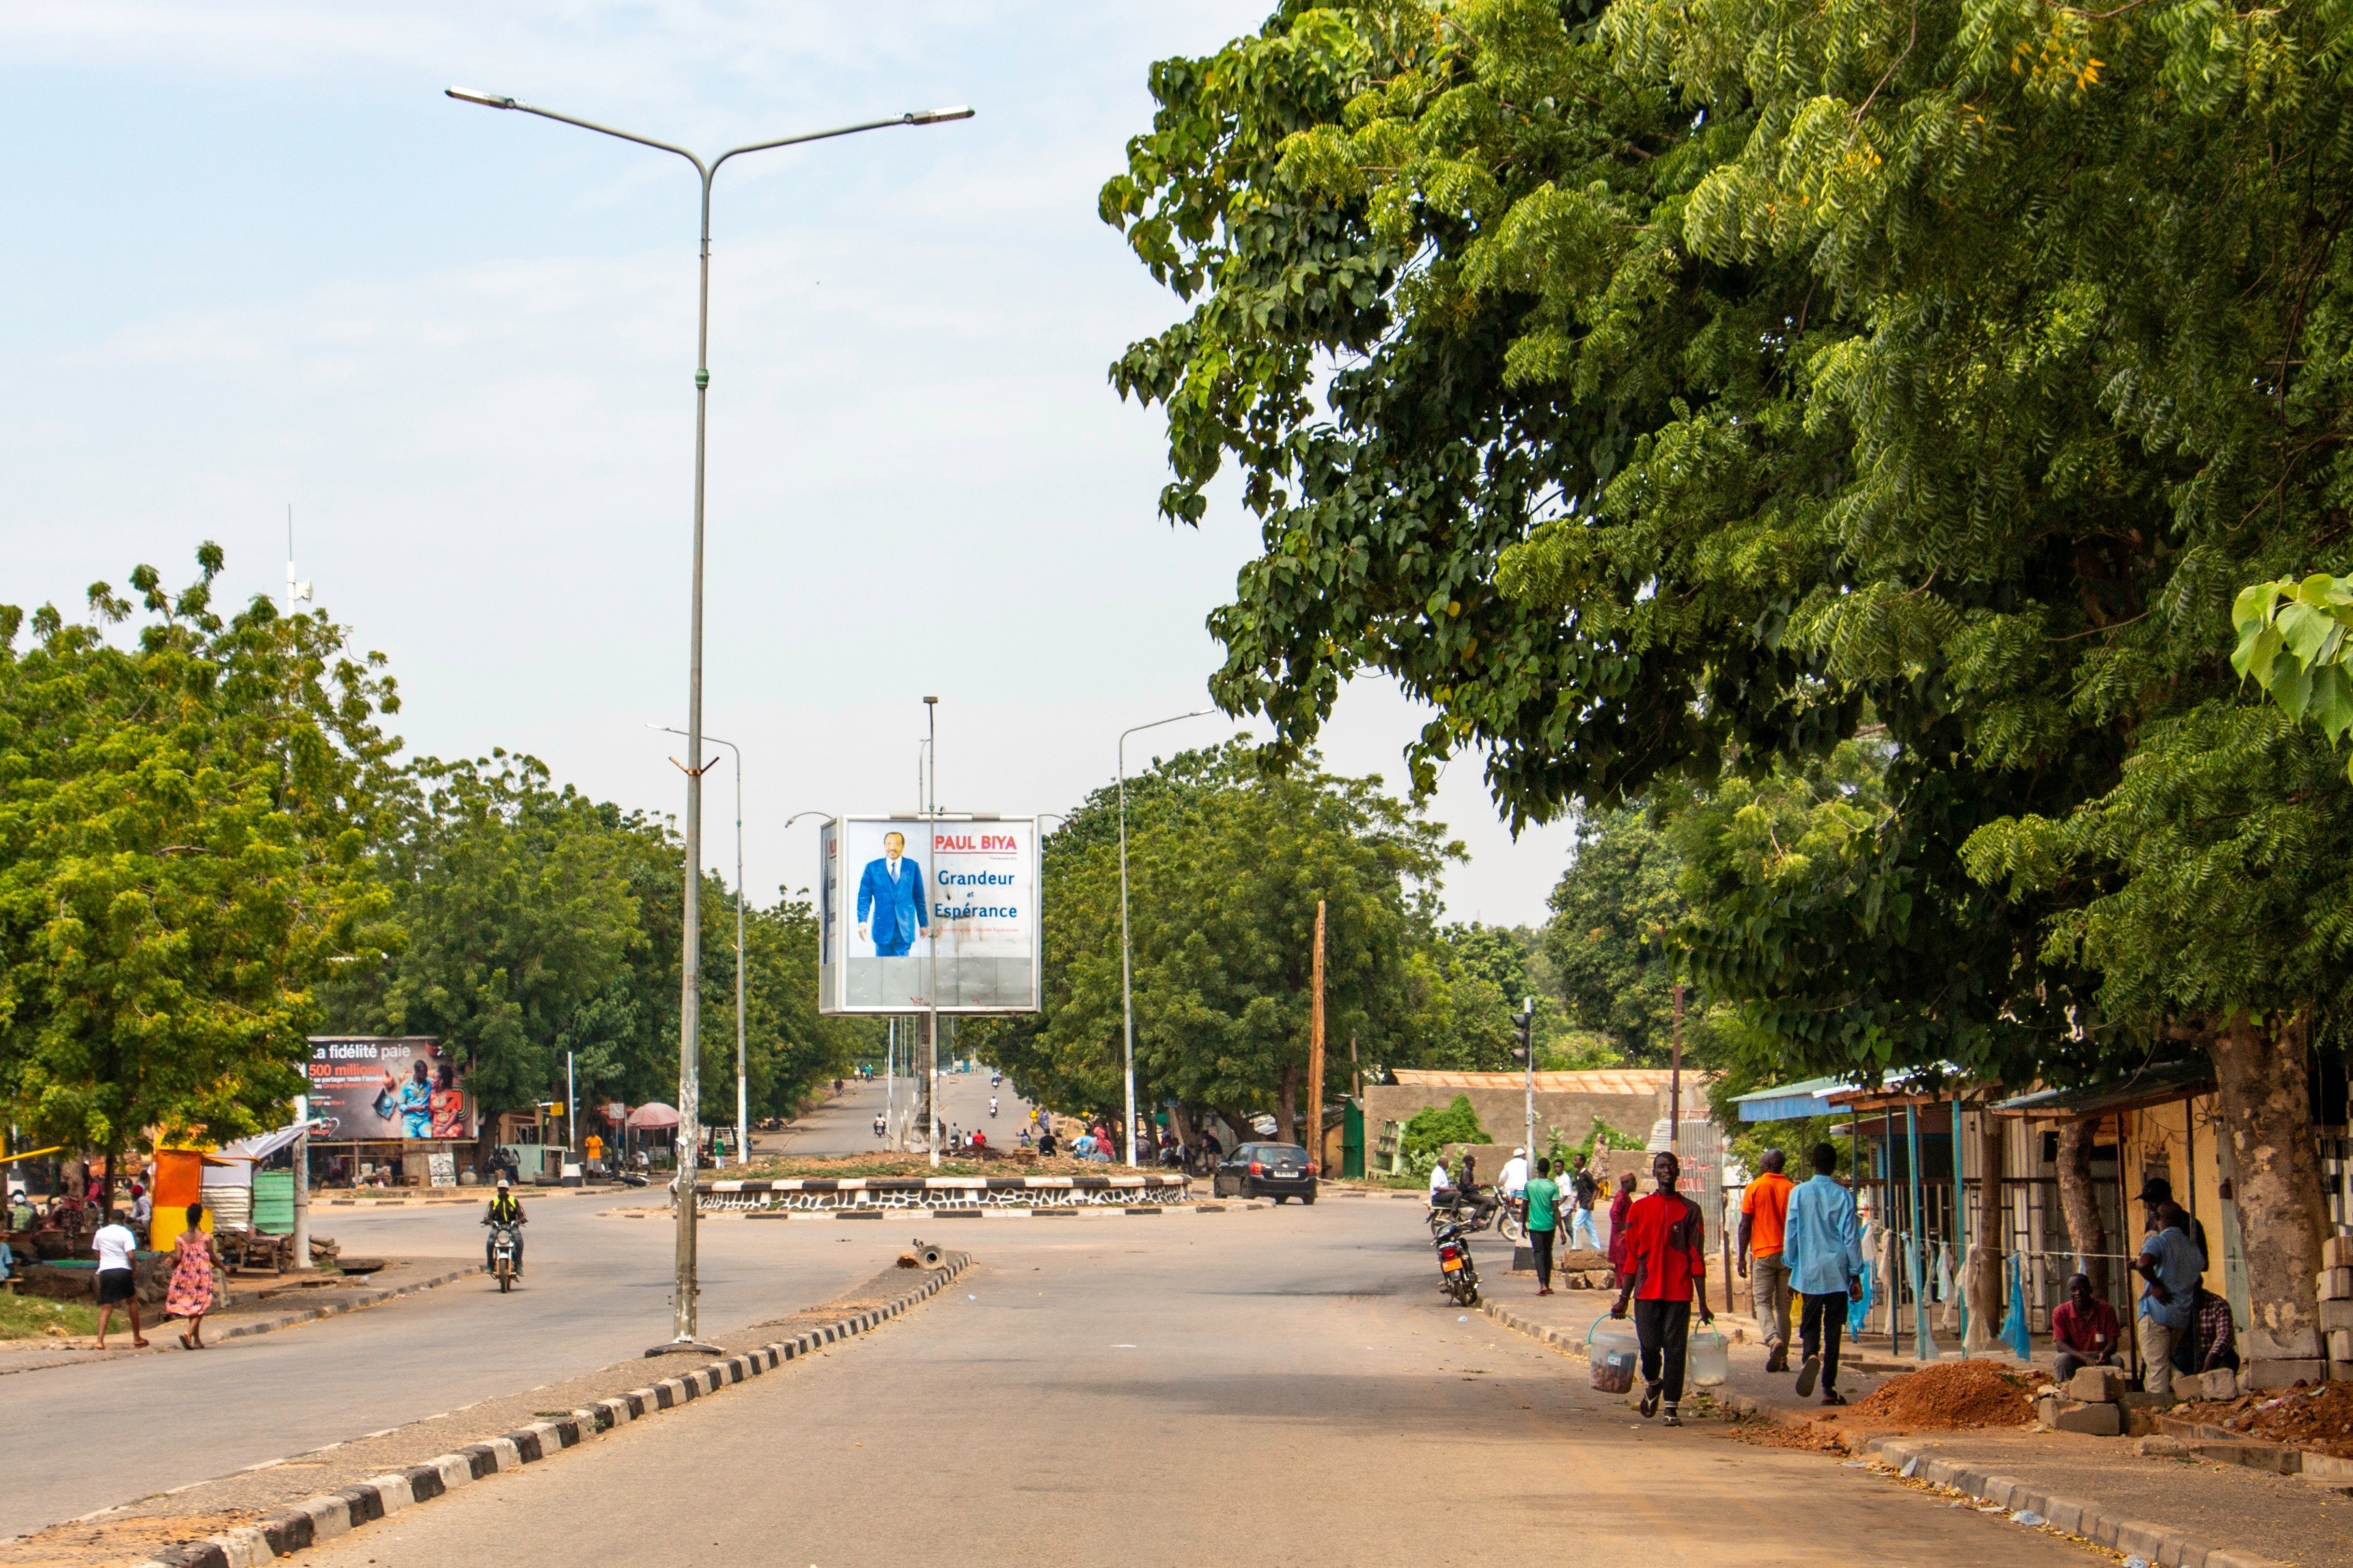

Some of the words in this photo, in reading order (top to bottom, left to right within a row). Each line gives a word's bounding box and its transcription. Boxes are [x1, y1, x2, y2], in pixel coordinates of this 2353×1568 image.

[935, 836, 976, 850] PAUL
[981, 836, 1017, 850] BIYA
[938, 870, 1015, 886] Grandeur
[935, 903, 1017, 921] Espérance
[329, 1043, 377, 1059] fidélité
[381, 1044, 411, 1060] paie
[308, 1064, 331, 1077] 500
[335, 1063, 383, 1076] millions
